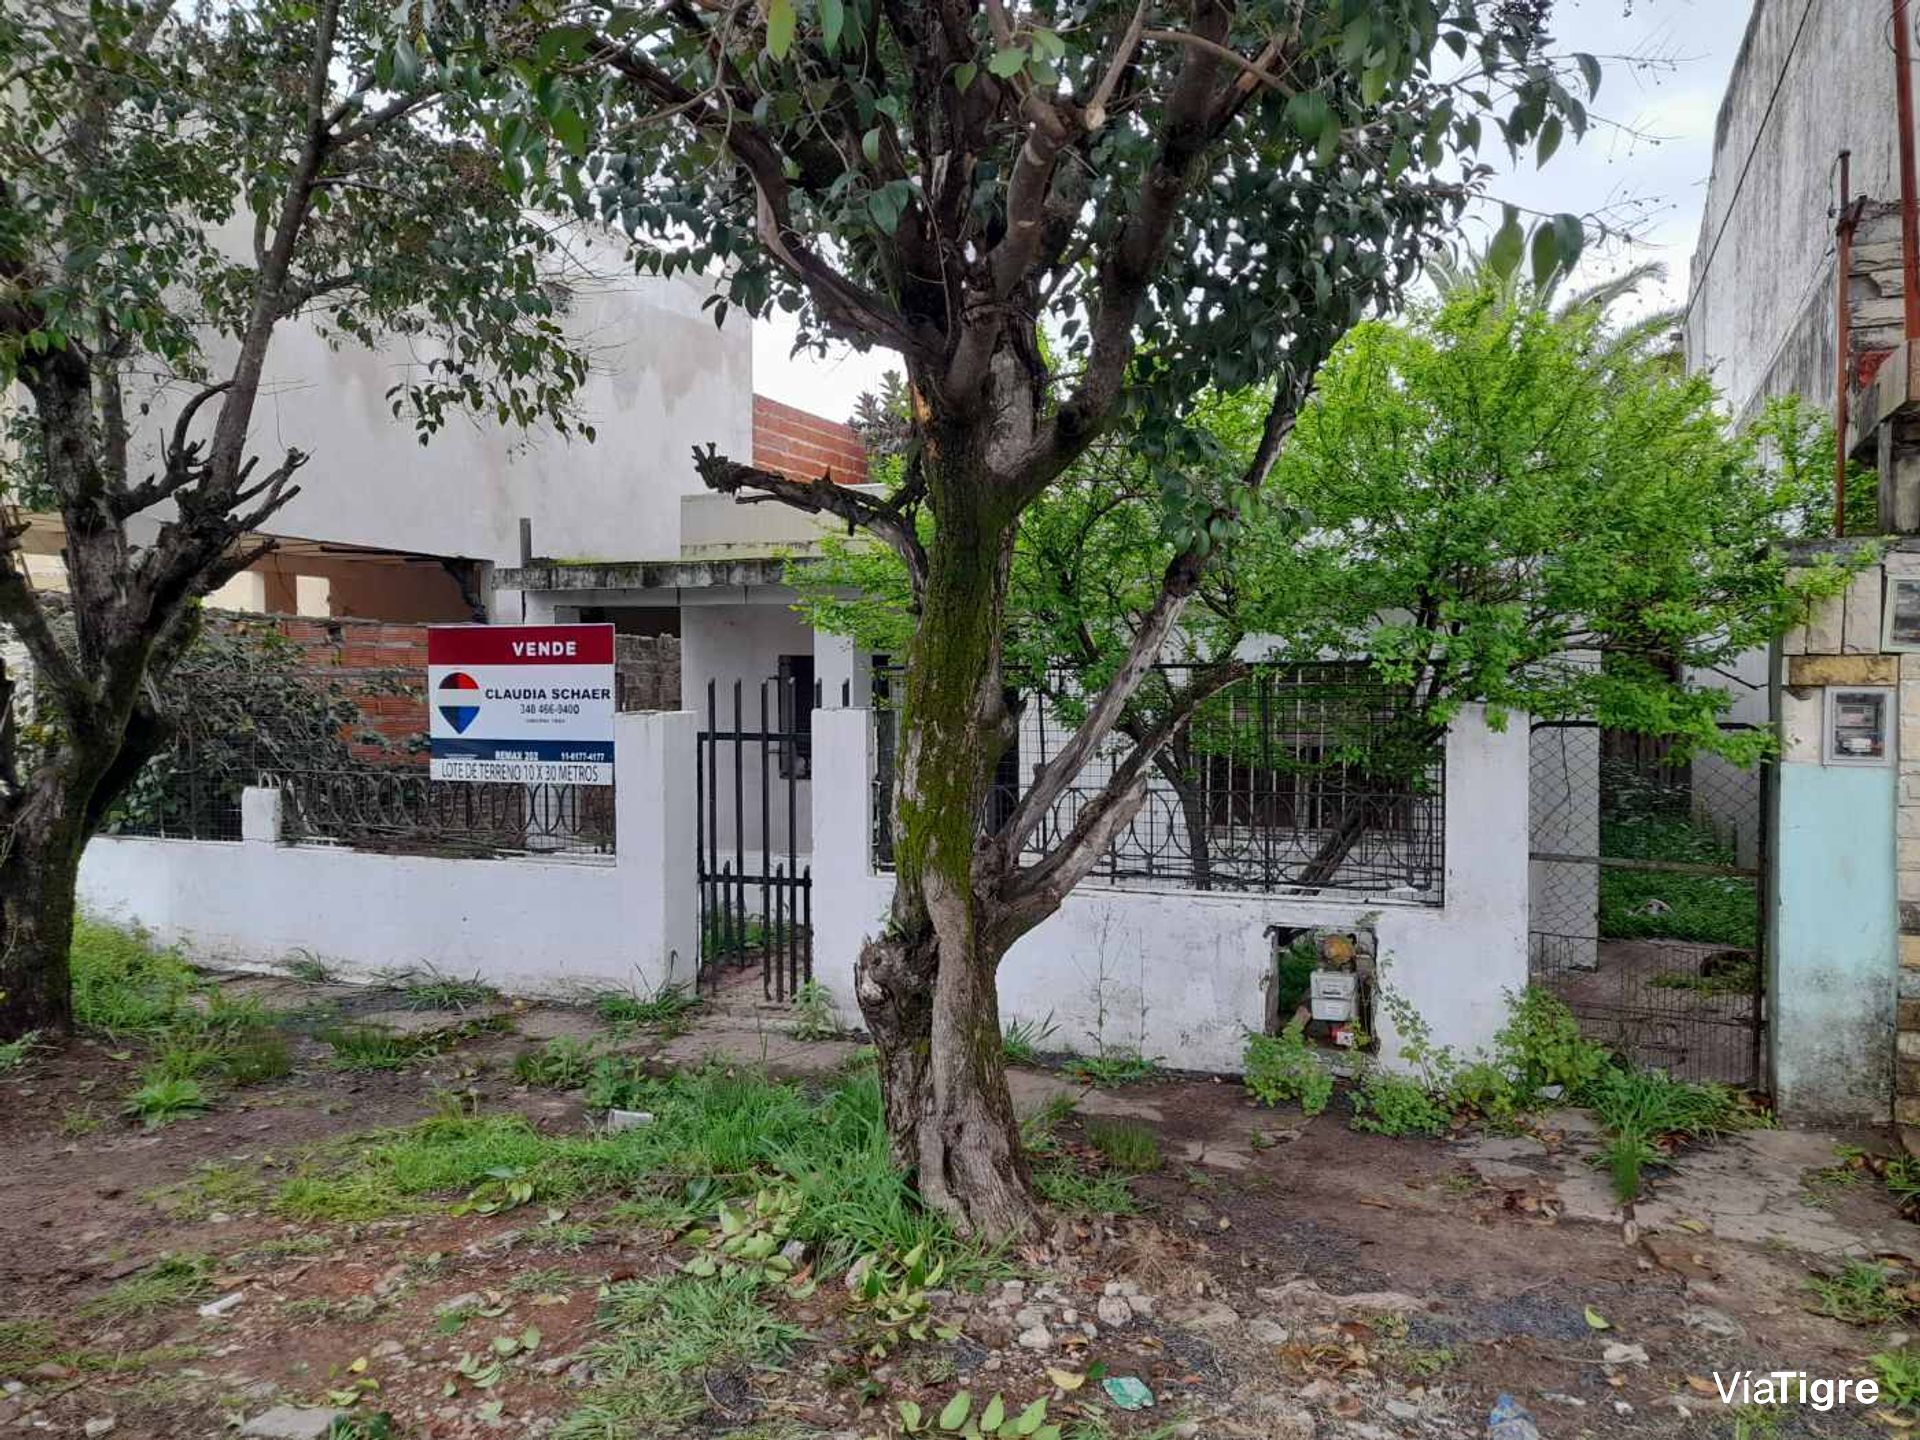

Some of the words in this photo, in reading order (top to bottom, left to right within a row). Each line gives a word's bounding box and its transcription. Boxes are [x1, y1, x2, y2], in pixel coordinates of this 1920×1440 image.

[512, 641, 577, 657] VENDE
[485, 688, 547, 700] CLAUDIA
[551, 688, 611, 700] SCHAER
[441, 762, 464, 778] LOTE
[465, 763, 477, 779] DE
[480, 764, 521, 780] TERRENO
[524, 765, 535, 780] 10
[536, 765, 543, 780] X
[544, 765, 557, 781] 30
[559, 765, 599, 782] METROS
